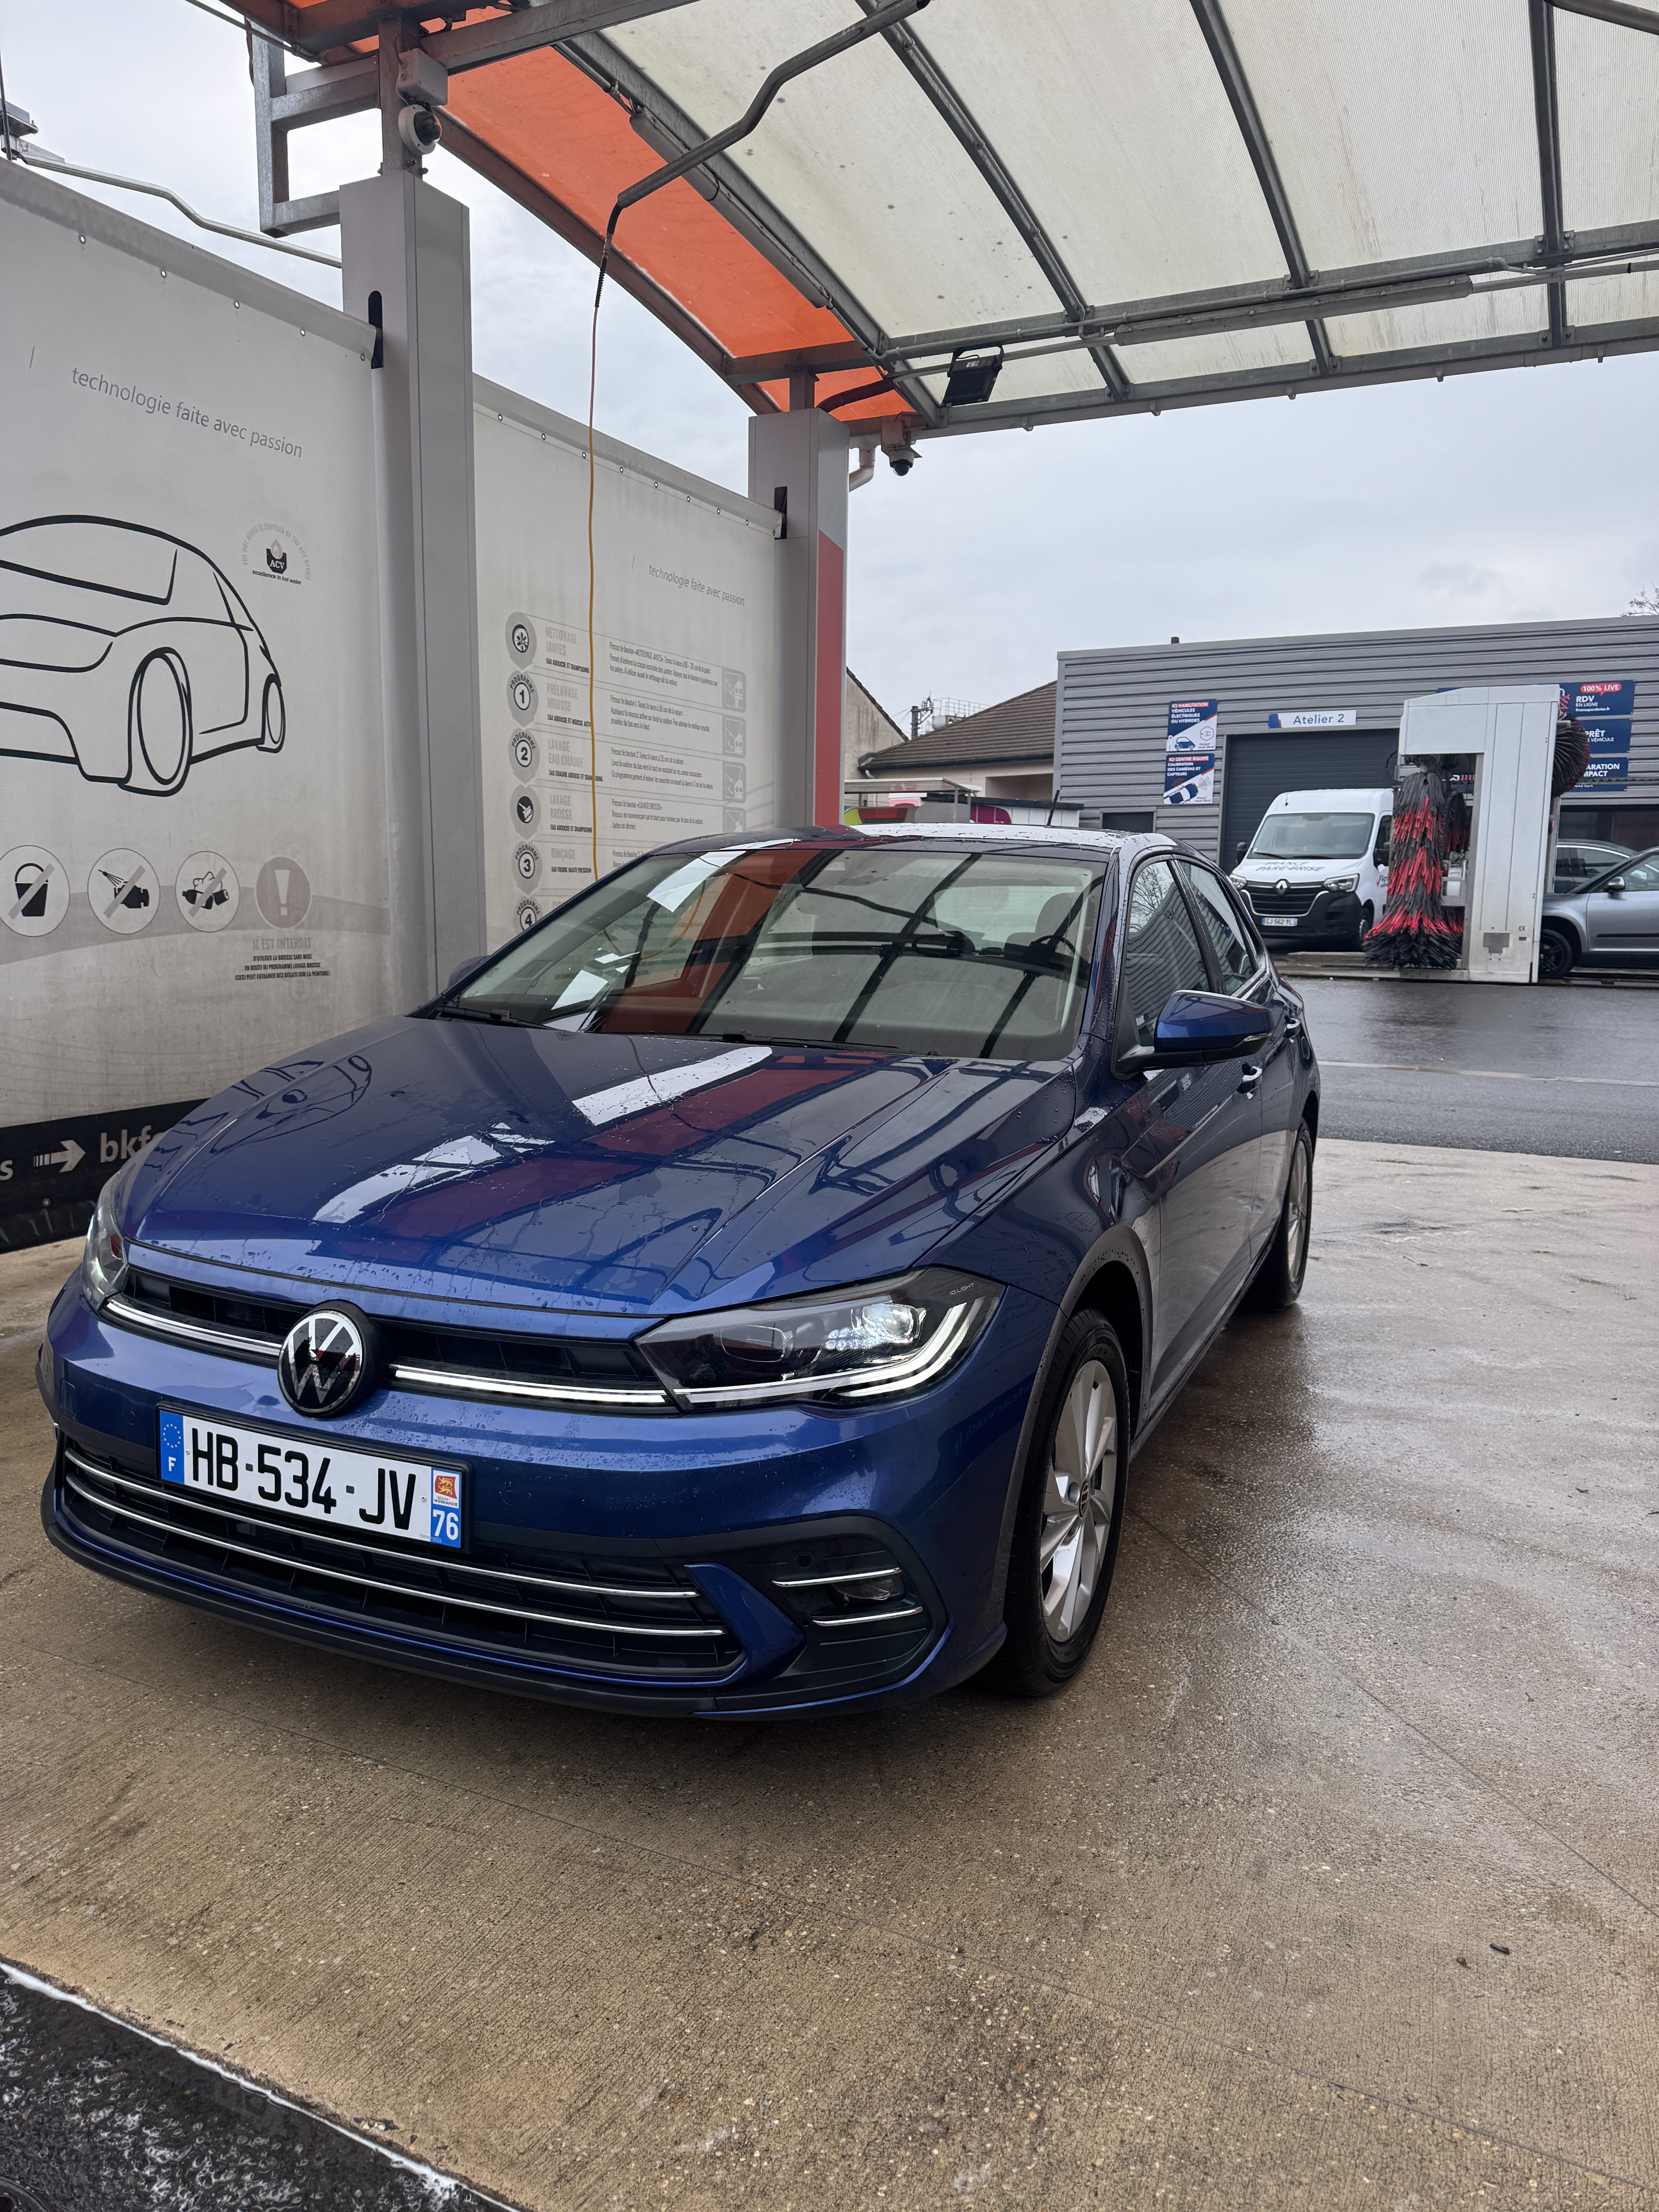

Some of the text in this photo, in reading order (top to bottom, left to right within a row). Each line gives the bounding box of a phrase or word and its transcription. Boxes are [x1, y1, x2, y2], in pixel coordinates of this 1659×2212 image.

[72, 368, 302, 457] technologie faite avec passion
[270, 560, 285, 569] ACV
[252, 570, 276, 579] excellence
[649, 565, 744, 606] technologie faite avec passion
[545, 626, 577, 644] NETTOYAGE
[546, 641, 566, 656] JANTES
[510, 675, 535, 693] PROGRAMME
[547, 682, 578, 699] PRÉLAVAGE
[520, 690, 525, 704] 1
[548, 697, 571, 712] MOUSSE
[1293, 714, 1344, 725] Atelier 2
[1585, 729, 1606, 737] PRÊT
[511, 732, 536, 750] PROGRAMME
[548, 739, 570, 752] LAVAGE
[521, 747, 528, 761] 2
[549, 753, 584, 768] EAU CHAUDE
[550, 794, 571, 806] LAVAGE
[550, 808, 572, 820] BROSSE
[515, 845, 539, 861] PROGRAMME
[551, 848, 576, 861] RINÇAGE
[524, 859, 531, 872] 3
[517, 900, 541, 915] PROGRAMME
[525, 914, 532, 927] 4
[252, 937, 312, 950] IL EST INTERDIT
[100, 1125, 164, 1163] bkf
[950, 1283, 974, 1295] IQ.LIGHT
[168, 1456, 177, 1472] F
[433, 1509, 459, 1540] 76
